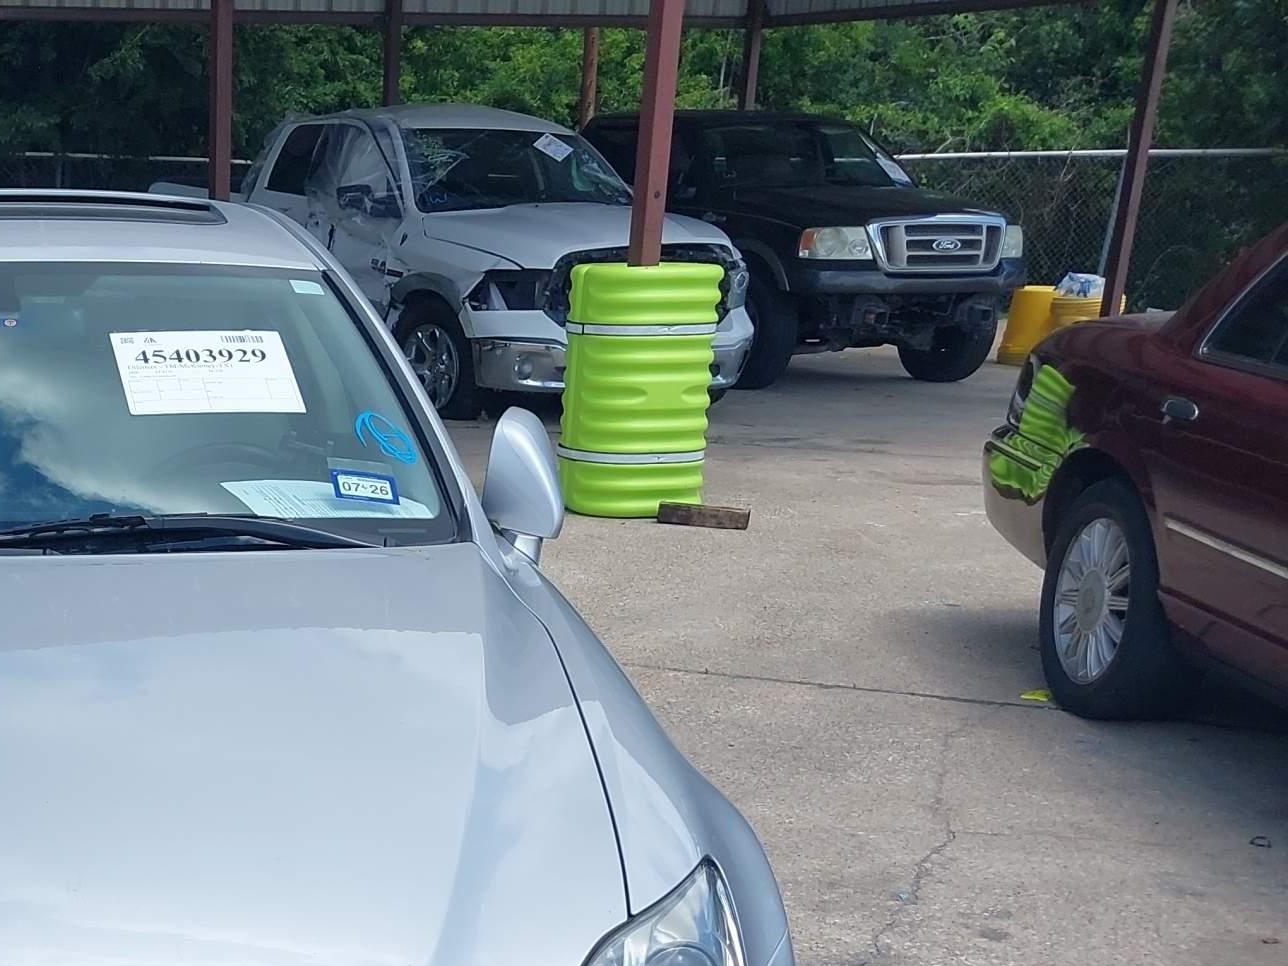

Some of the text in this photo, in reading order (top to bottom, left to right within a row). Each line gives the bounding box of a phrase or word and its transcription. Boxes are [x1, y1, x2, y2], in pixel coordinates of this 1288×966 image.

[135, 347, 267, 364] 45403929
[341, 481, 390, 496] 07 26
